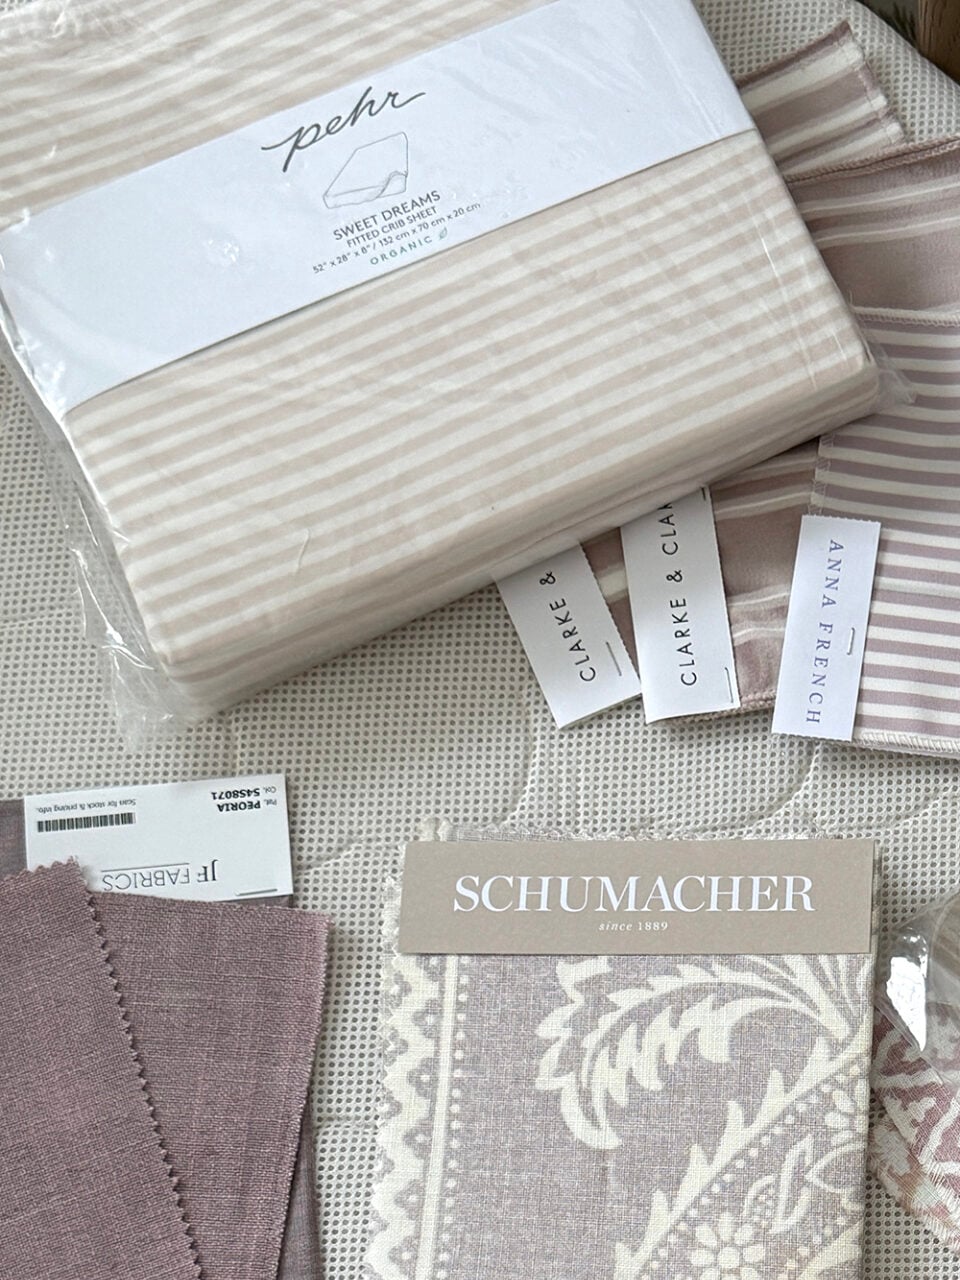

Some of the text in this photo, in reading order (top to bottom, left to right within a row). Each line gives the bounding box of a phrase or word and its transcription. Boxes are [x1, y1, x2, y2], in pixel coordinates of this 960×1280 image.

[261, 86, 426, 172] pehr
[333, 190, 441, 241] SWEET DREAMS
[346, 206, 437, 248] FITTED CRIB SHEET
[395, 231, 410, 241] cm
[417, 222, 429, 233] 70
[431, 217, 446, 227] cm
[453, 207, 465, 218] 20
[466, 203, 481, 212] cm
[370, 236, 432, 265] ORGANIC
[667, 570, 683, 583] &
[539, 570, 597, 682] CLARKE &
[670, 598, 697, 686] CLARKE
[806, 539, 844, 724] ANNA FRENCH
[217, 801, 260, 812] PEORIA
[103, 859, 219, 891] JF FABRICS
[453, 875, 815, 912] SCHUMACHER
[599, 921, 668, 931] since 1889
